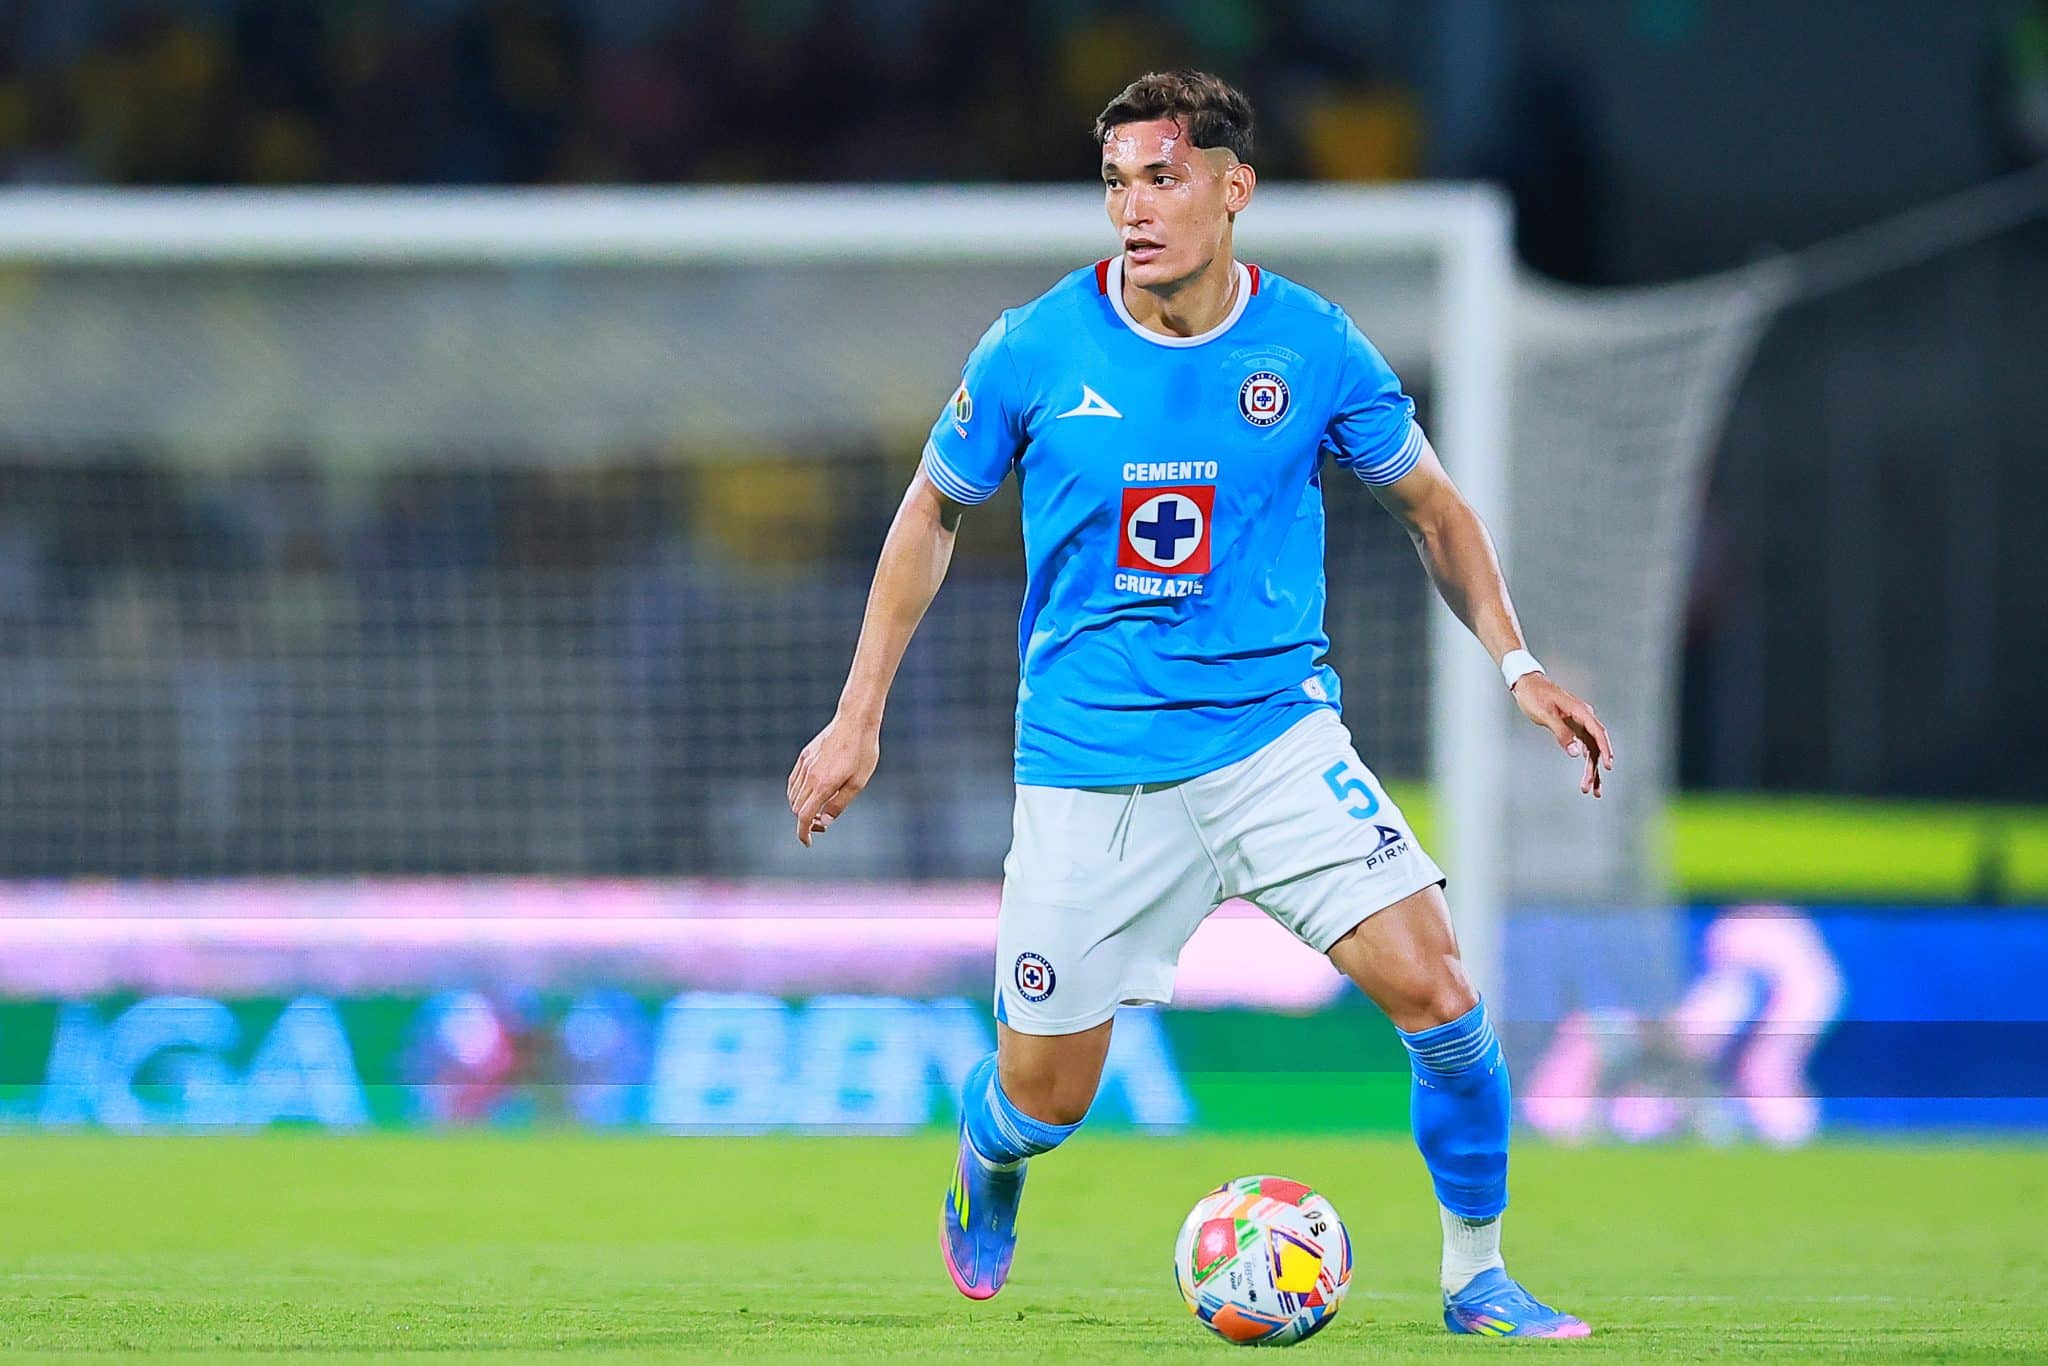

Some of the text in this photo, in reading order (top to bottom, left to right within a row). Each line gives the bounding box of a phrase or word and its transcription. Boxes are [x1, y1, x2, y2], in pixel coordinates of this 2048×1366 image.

[1122, 460, 1218, 482] CEMENTO
[1114, 573, 1162, 596] CRUZ
[1322, 760, 1380, 820] 5
